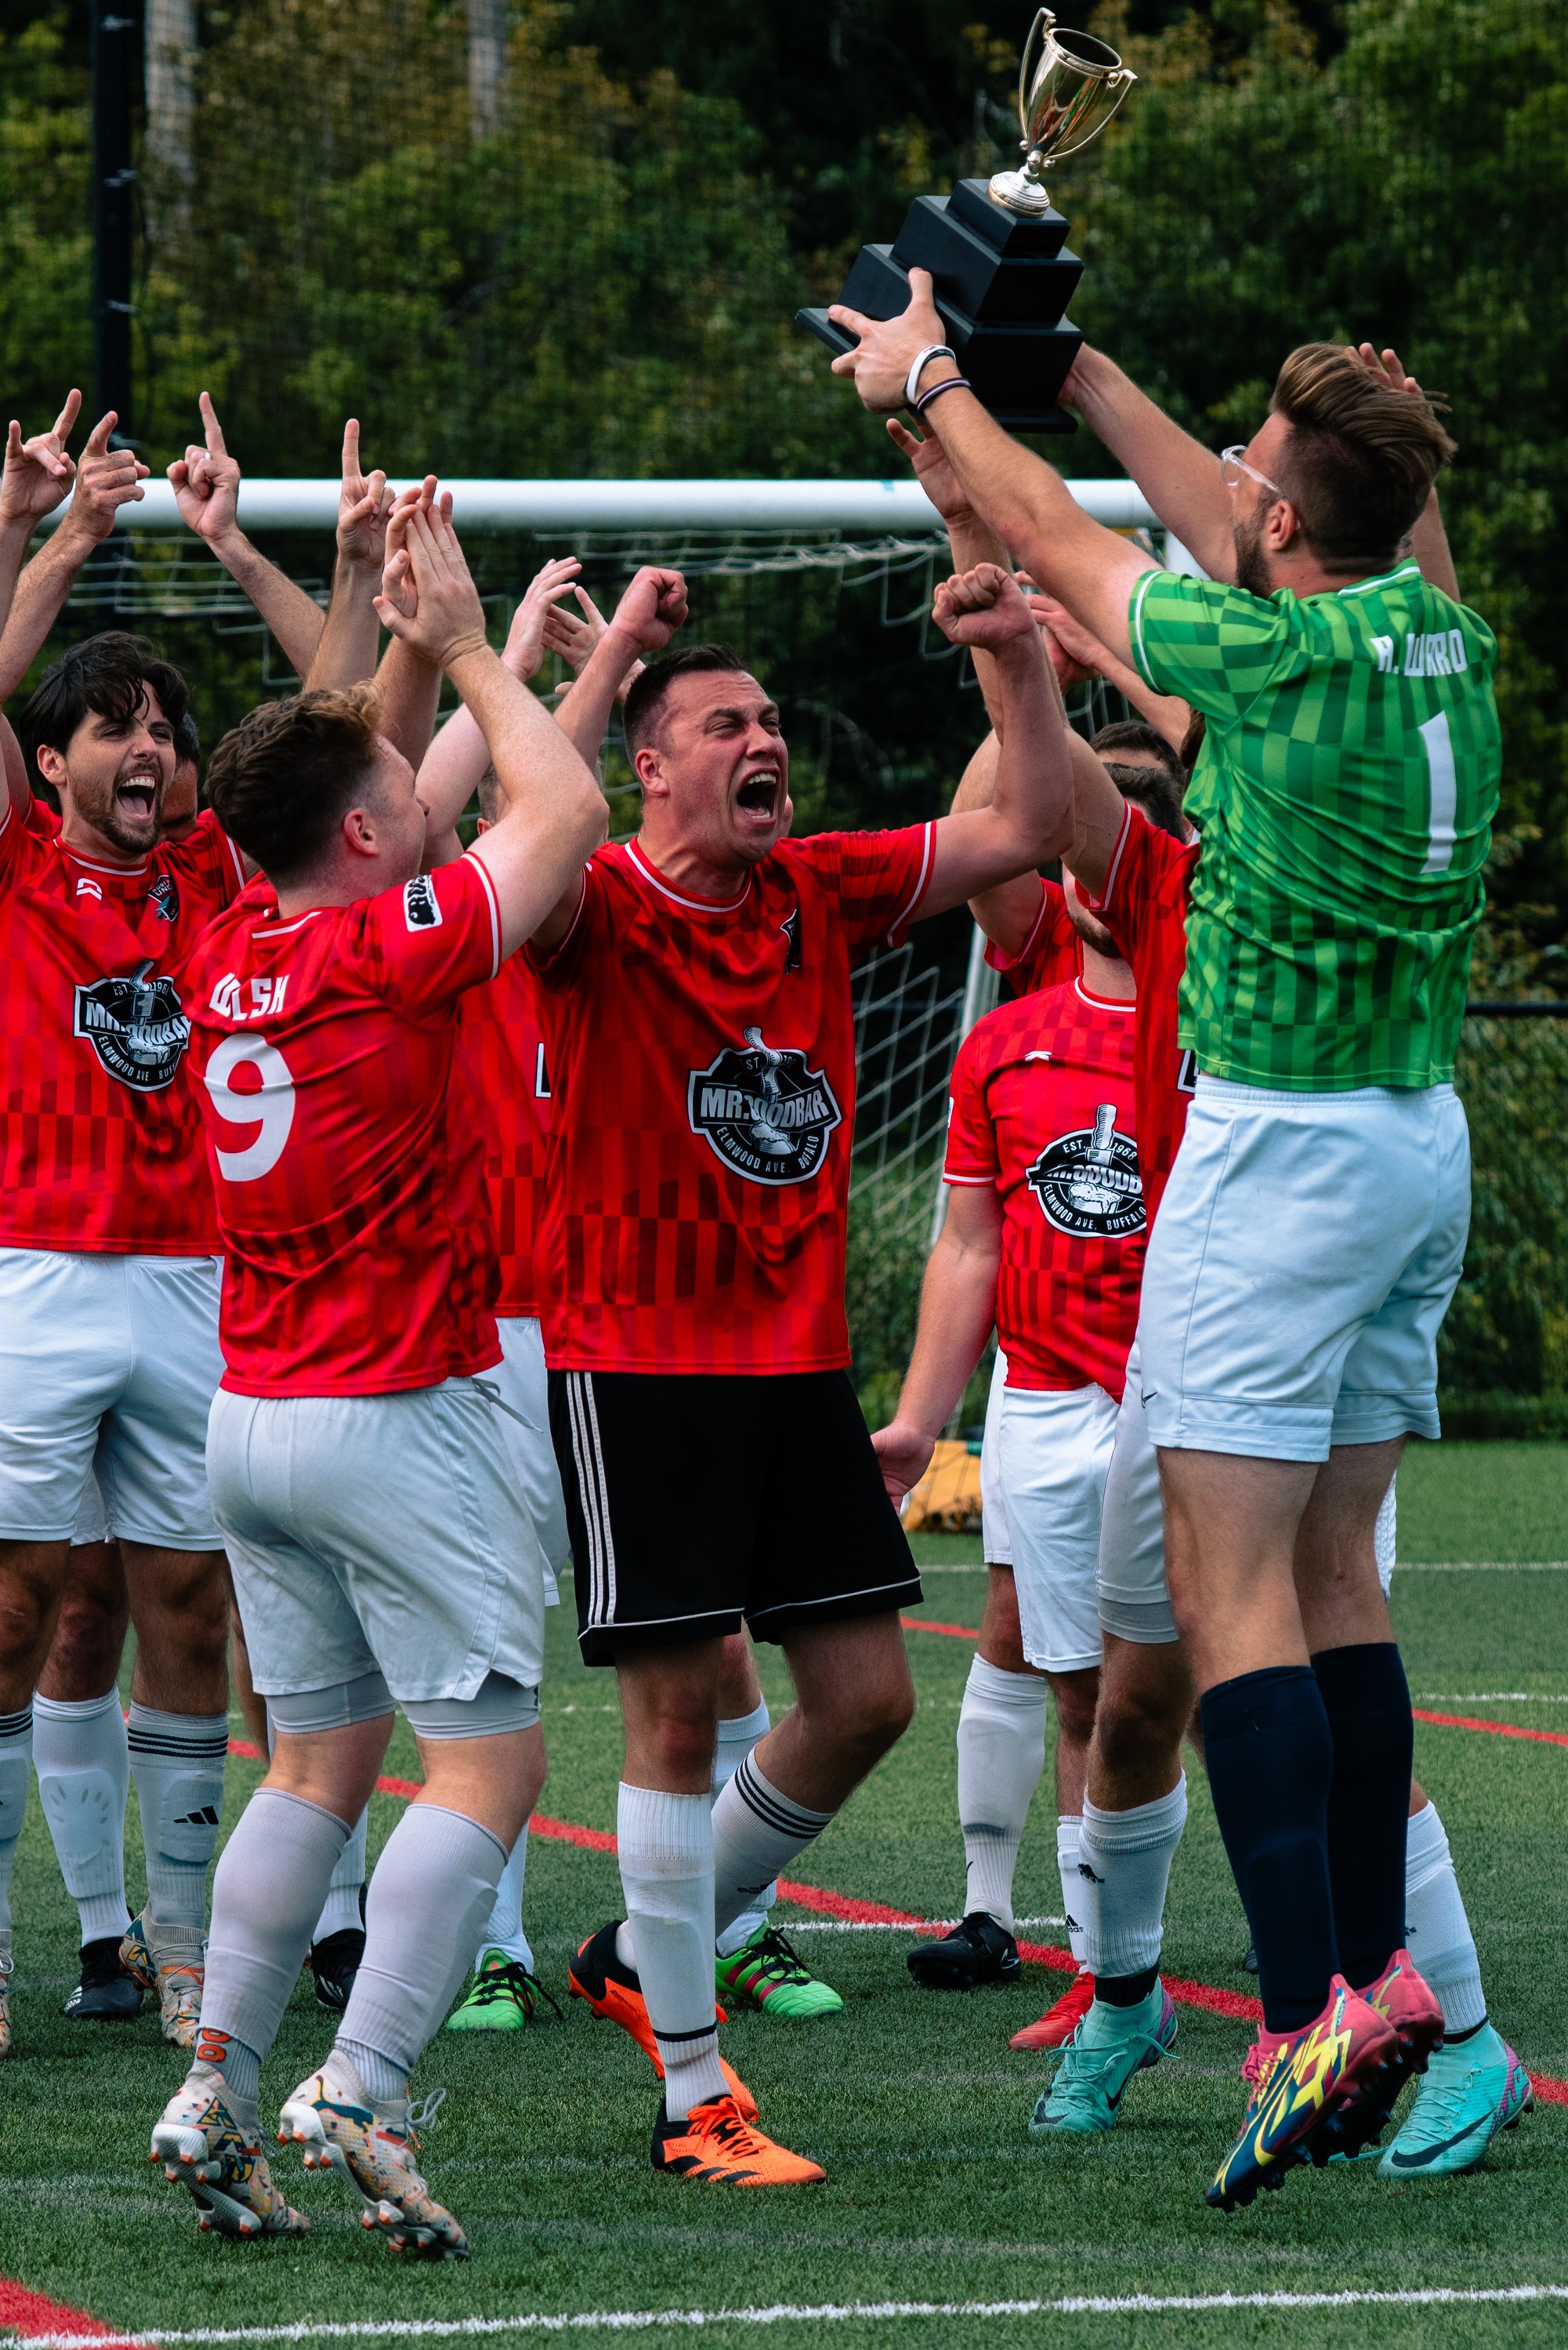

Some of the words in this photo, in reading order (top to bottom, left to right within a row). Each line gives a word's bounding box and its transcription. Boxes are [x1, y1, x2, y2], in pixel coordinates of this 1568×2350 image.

[1371, 636, 1399, 674] A.
[1404, 629, 1467, 676] WARD
[1418, 711, 1458, 873] 1
[209, 973, 289, 1021] WLSH
[99, 1035, 134, 1076] ELMWOOD
[204, 1033, 295, 1182] 9
[717, 1126, 760, 1169] ELMWOOD
[766, 1161, 790, 1173] AVE.
[1063, 1140, 1086, 1153] EST.
[1113, 1143, 1137, 1160] 1968
[1044, 1184, 1073, 1222] ELMWOOD
[1075, 1217, 1097, 1230] AVE.
